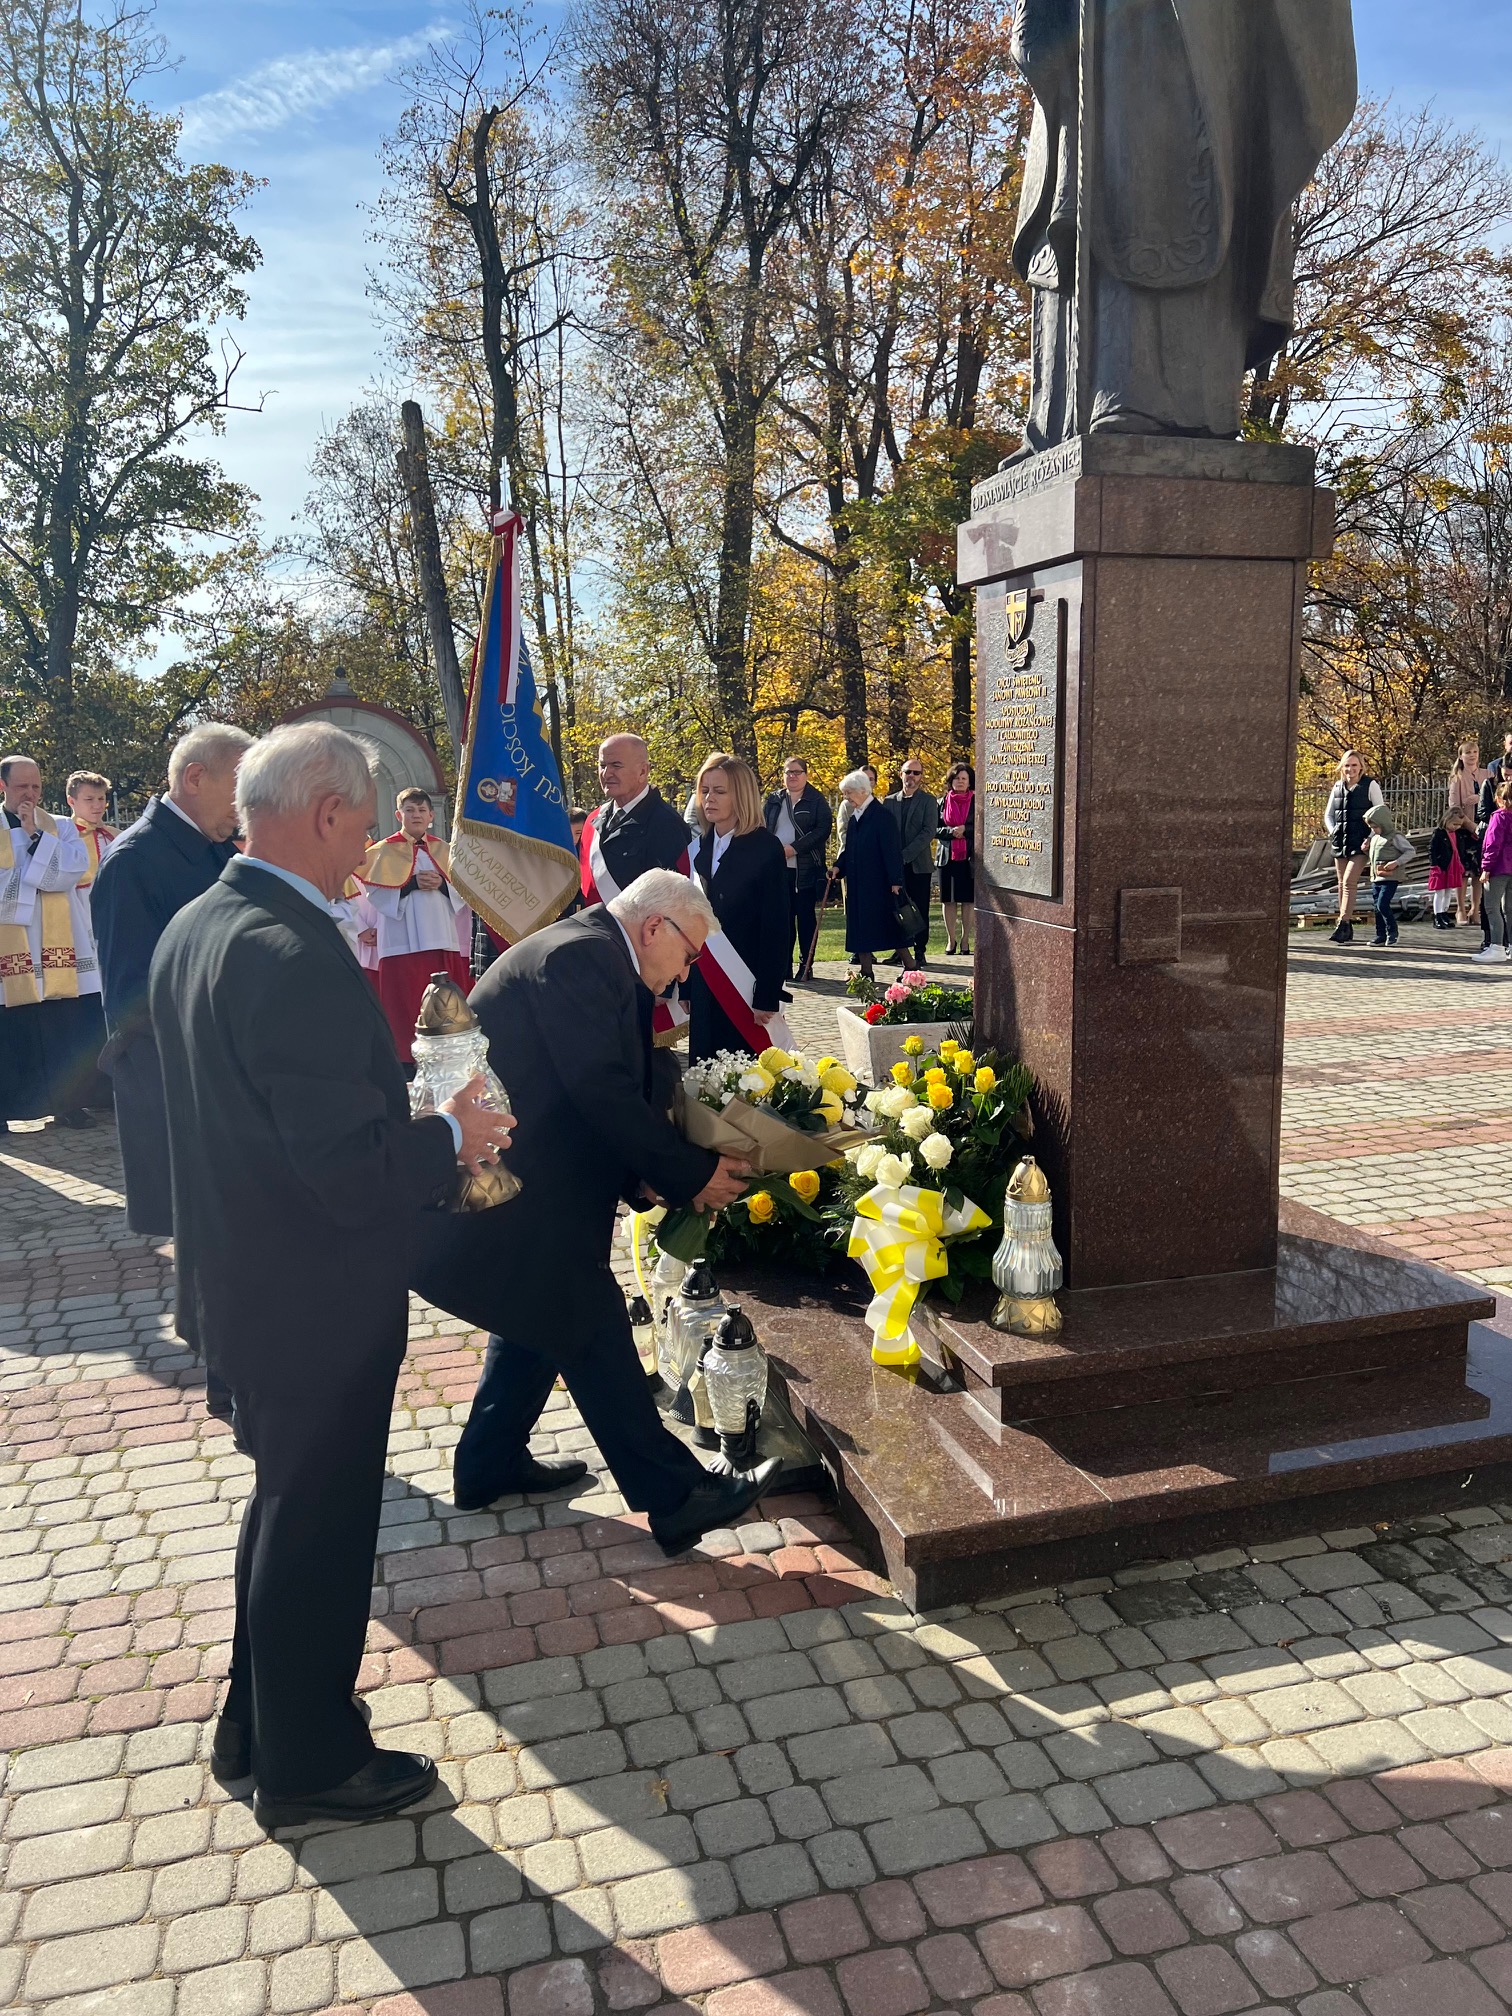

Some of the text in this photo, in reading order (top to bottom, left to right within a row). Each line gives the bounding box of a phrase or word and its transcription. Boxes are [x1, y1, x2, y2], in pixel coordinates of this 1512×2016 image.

[972, 447, 1081, 511] ODMAWIAJCIE RÓŻANIEC
[452, 843, 512, 910] ARNOWSKIEJ
[467, 838, 540, 911] SZKAPLERZNEJ
